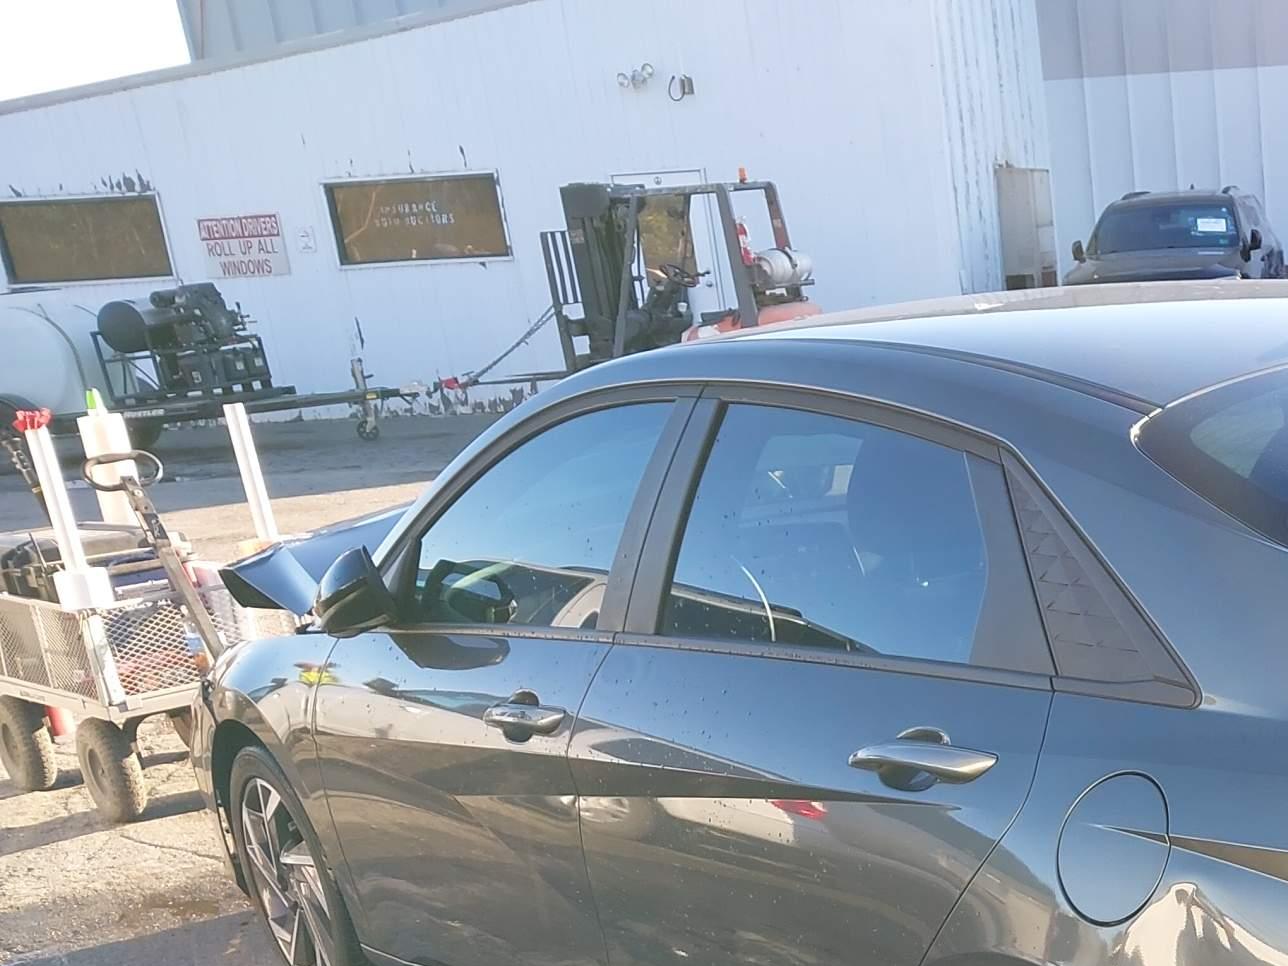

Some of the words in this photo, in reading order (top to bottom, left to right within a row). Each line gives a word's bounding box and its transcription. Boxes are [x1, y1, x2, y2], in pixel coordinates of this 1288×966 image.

[200, 219, 242, 240] ATTENTION
[241, 216, 279, 238] DRIVERS
[206, 241, 236, 257] ROLL
[239, 240, 253, 255] UP
[258, 238, 279, 254] ALL
[219, 258, 273, 276] WINDOWS
